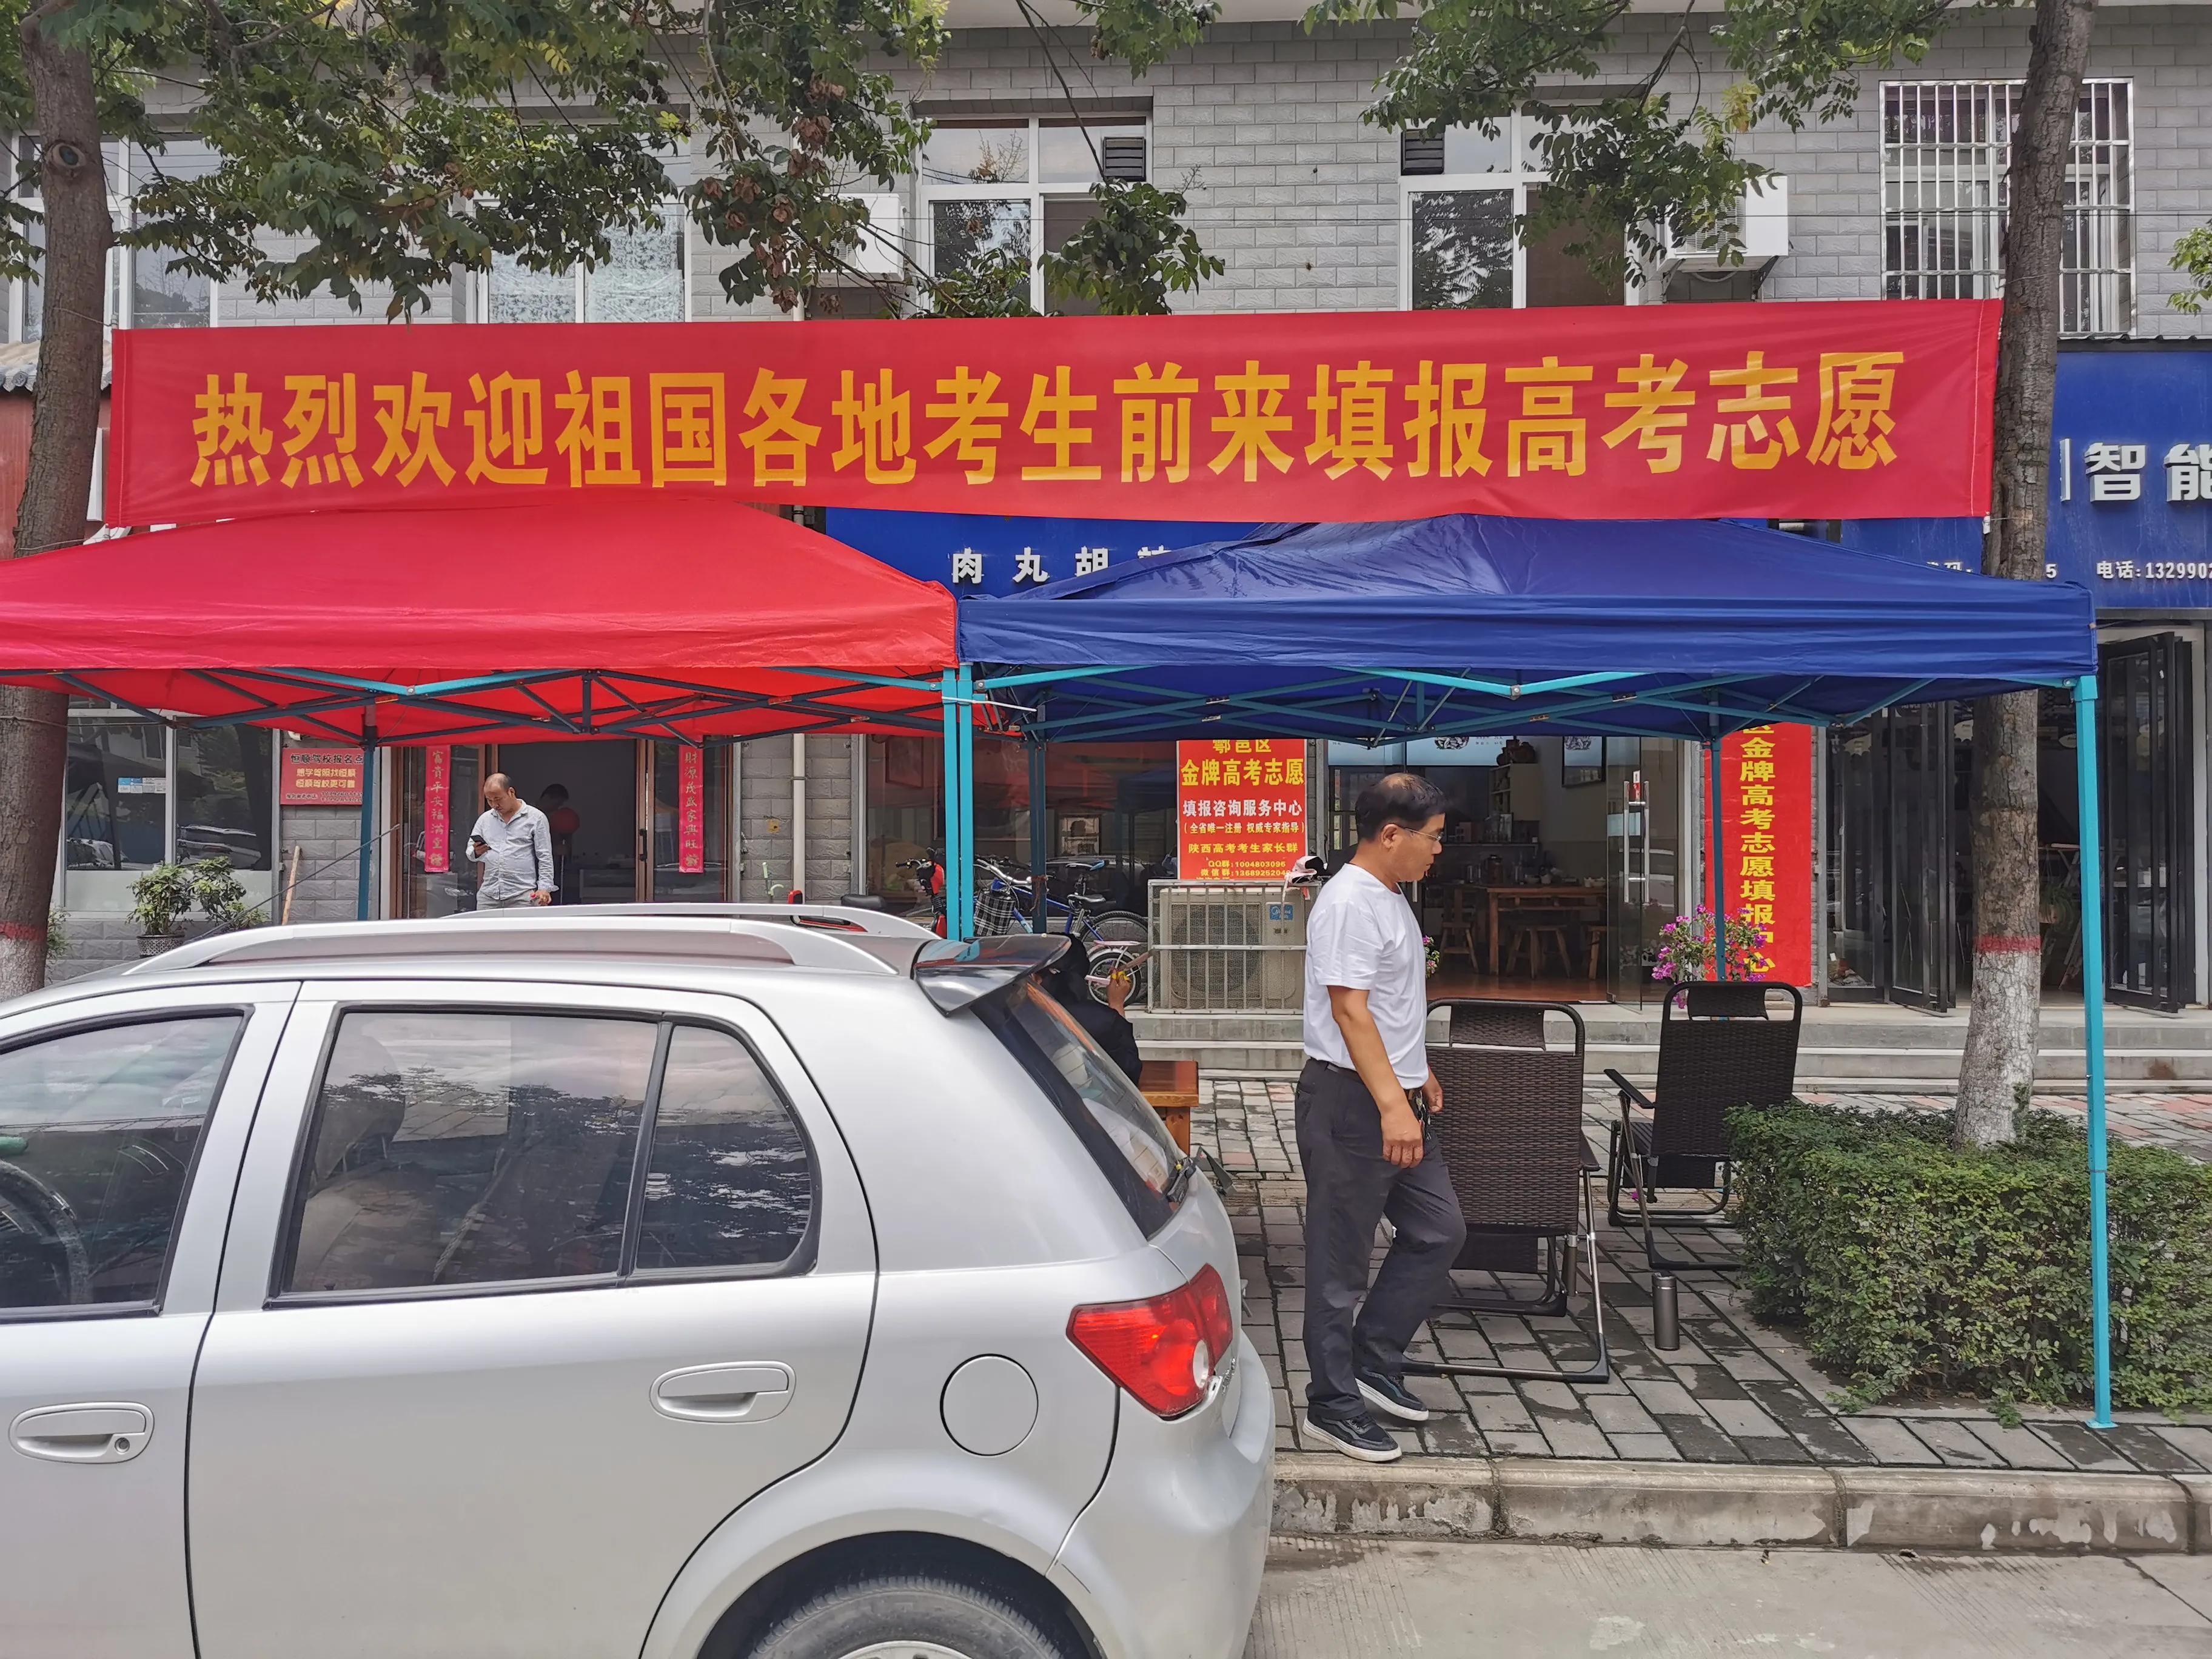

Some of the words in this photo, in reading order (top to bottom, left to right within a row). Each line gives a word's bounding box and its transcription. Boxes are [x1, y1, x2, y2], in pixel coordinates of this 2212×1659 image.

[190, 350, 1905, 489] 热烈欢迎祖国各地考生前来填报高考志愿
[2085, 442, 2212, 502] 智能
[953, 545, 1171, 584] 肉丸胡
[1181, 758, 1304, 786] 金牌高考志愿
[1183, 799, 1302, 817] 填报咨询服务中心
[1188, 843, 1298, 854] 陕西高考考生家长群
